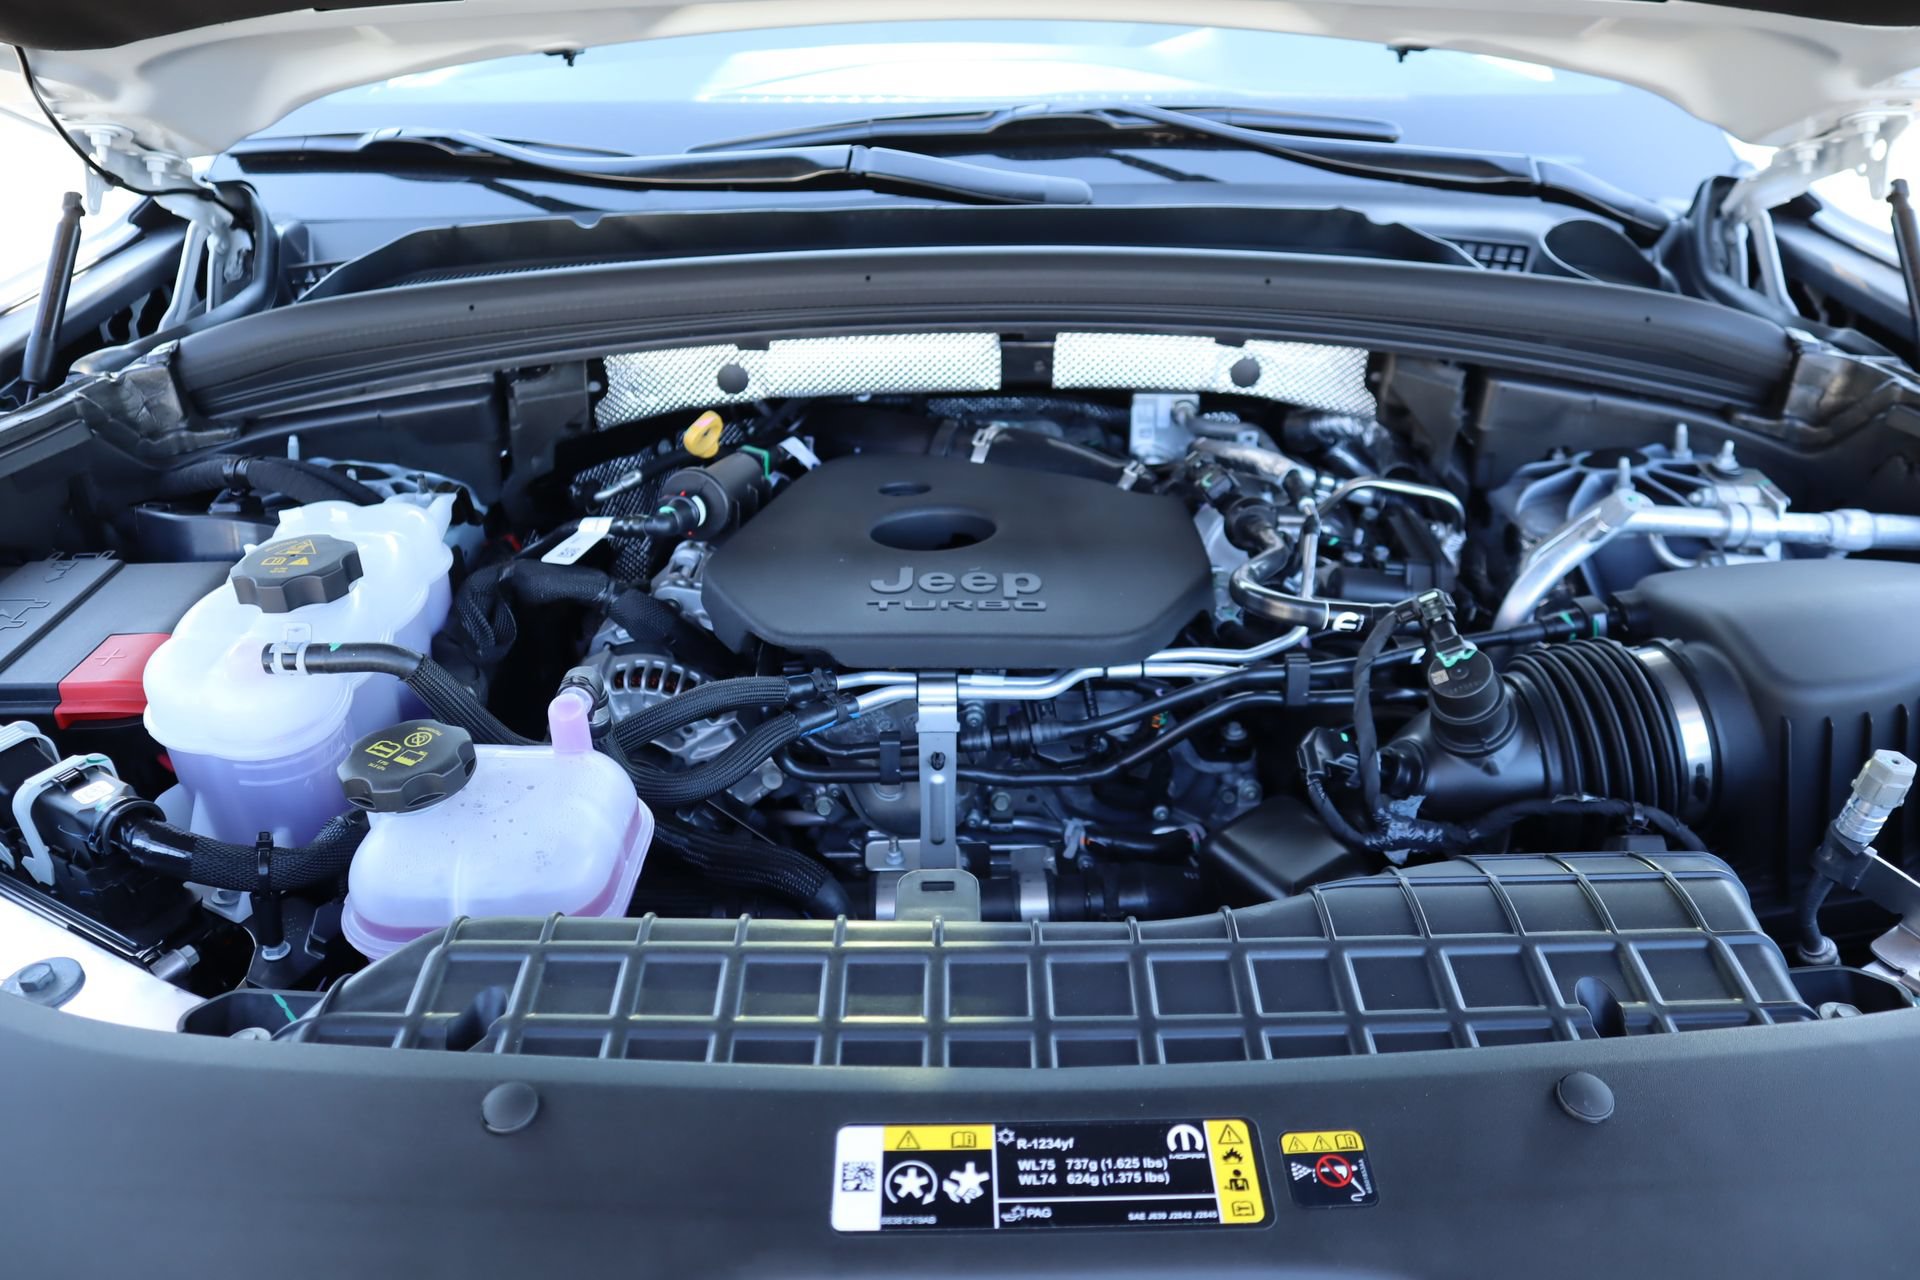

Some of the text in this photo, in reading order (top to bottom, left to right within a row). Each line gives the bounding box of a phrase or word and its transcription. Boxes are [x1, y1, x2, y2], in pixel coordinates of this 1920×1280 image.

[870, 566, 1042, 600] Jeep
[866, 599, 1047, 612] TURBO
[1016, 1138, 1074, 1151] R-1234yf
[1017, 1156, 1169, 1172] WL75 737g (1.625 lbs)
[1018, 1171, 1170, 1187] WL74 624g (1.375 lbs)
[1026, 1207, 1052, 1219] PAG
[1127, 1212, 1146, 1221] SAE
